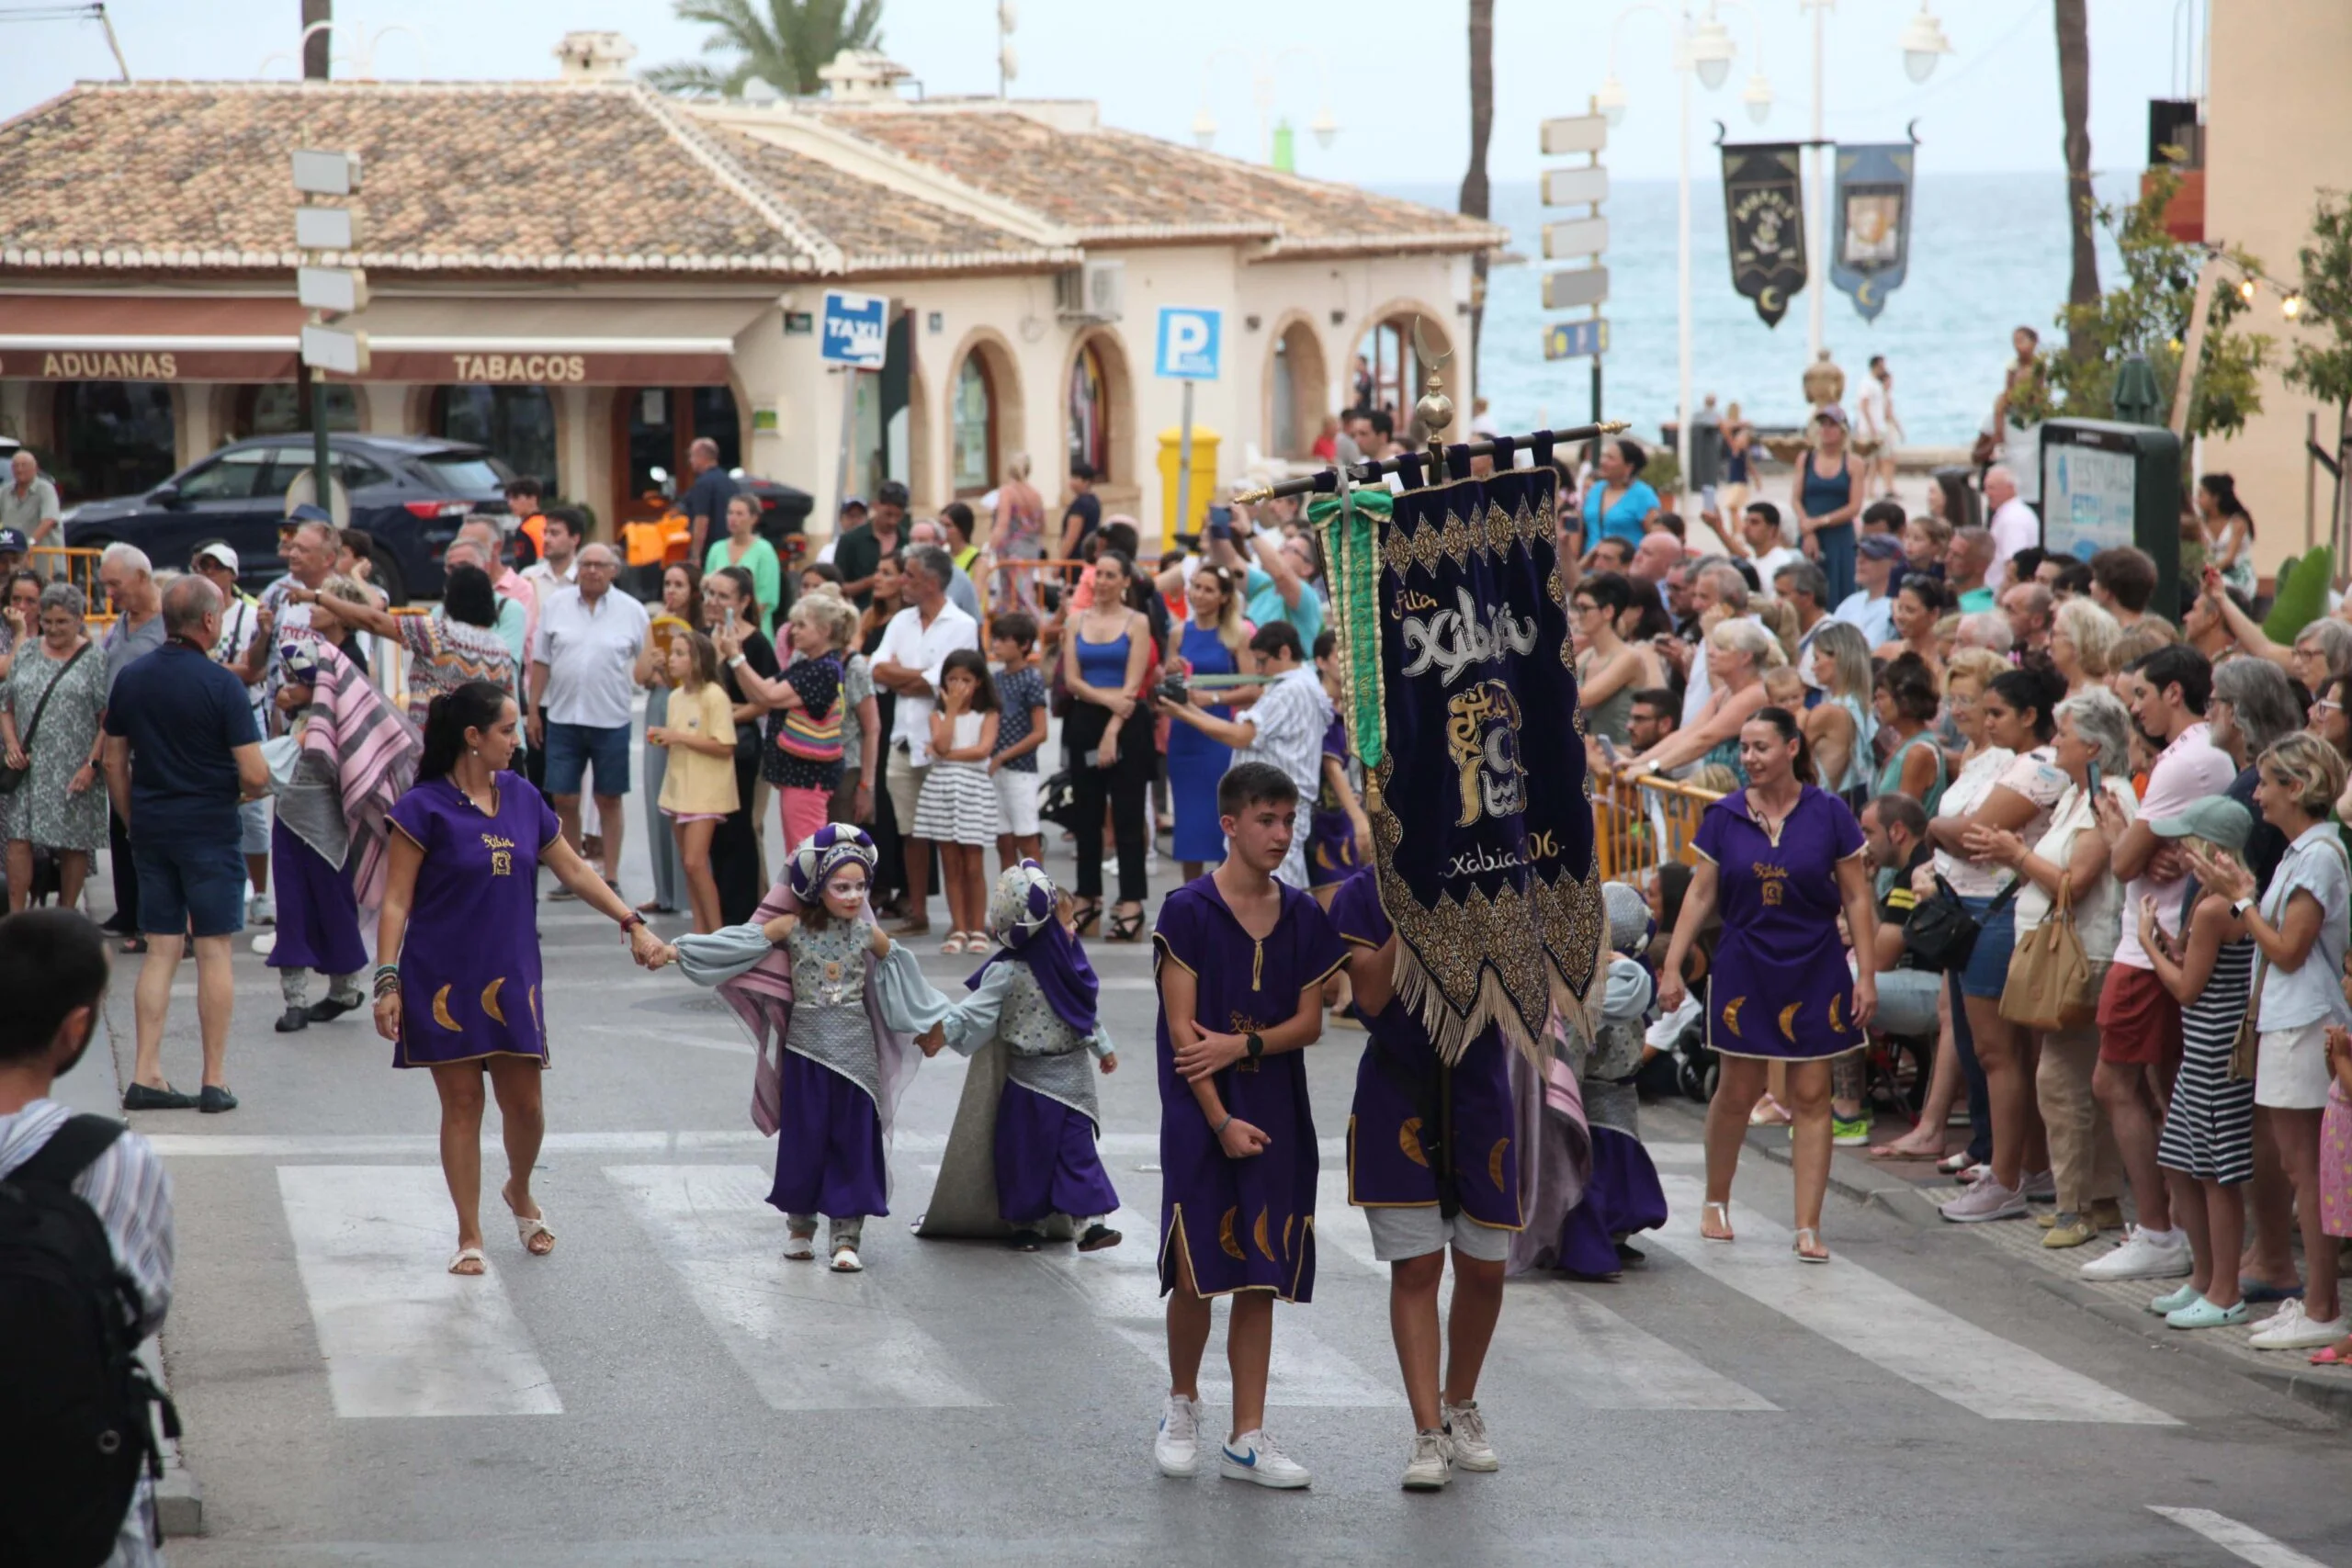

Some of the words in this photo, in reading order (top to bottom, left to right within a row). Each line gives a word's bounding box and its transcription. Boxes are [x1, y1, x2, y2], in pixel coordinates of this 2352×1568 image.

[828, 317, 879, 338] TAXI
[1168, 314, 1209, 370] P
[44, 353, 177, 378] ADUANAS
[453, 355, 585, 381] TABACOS
